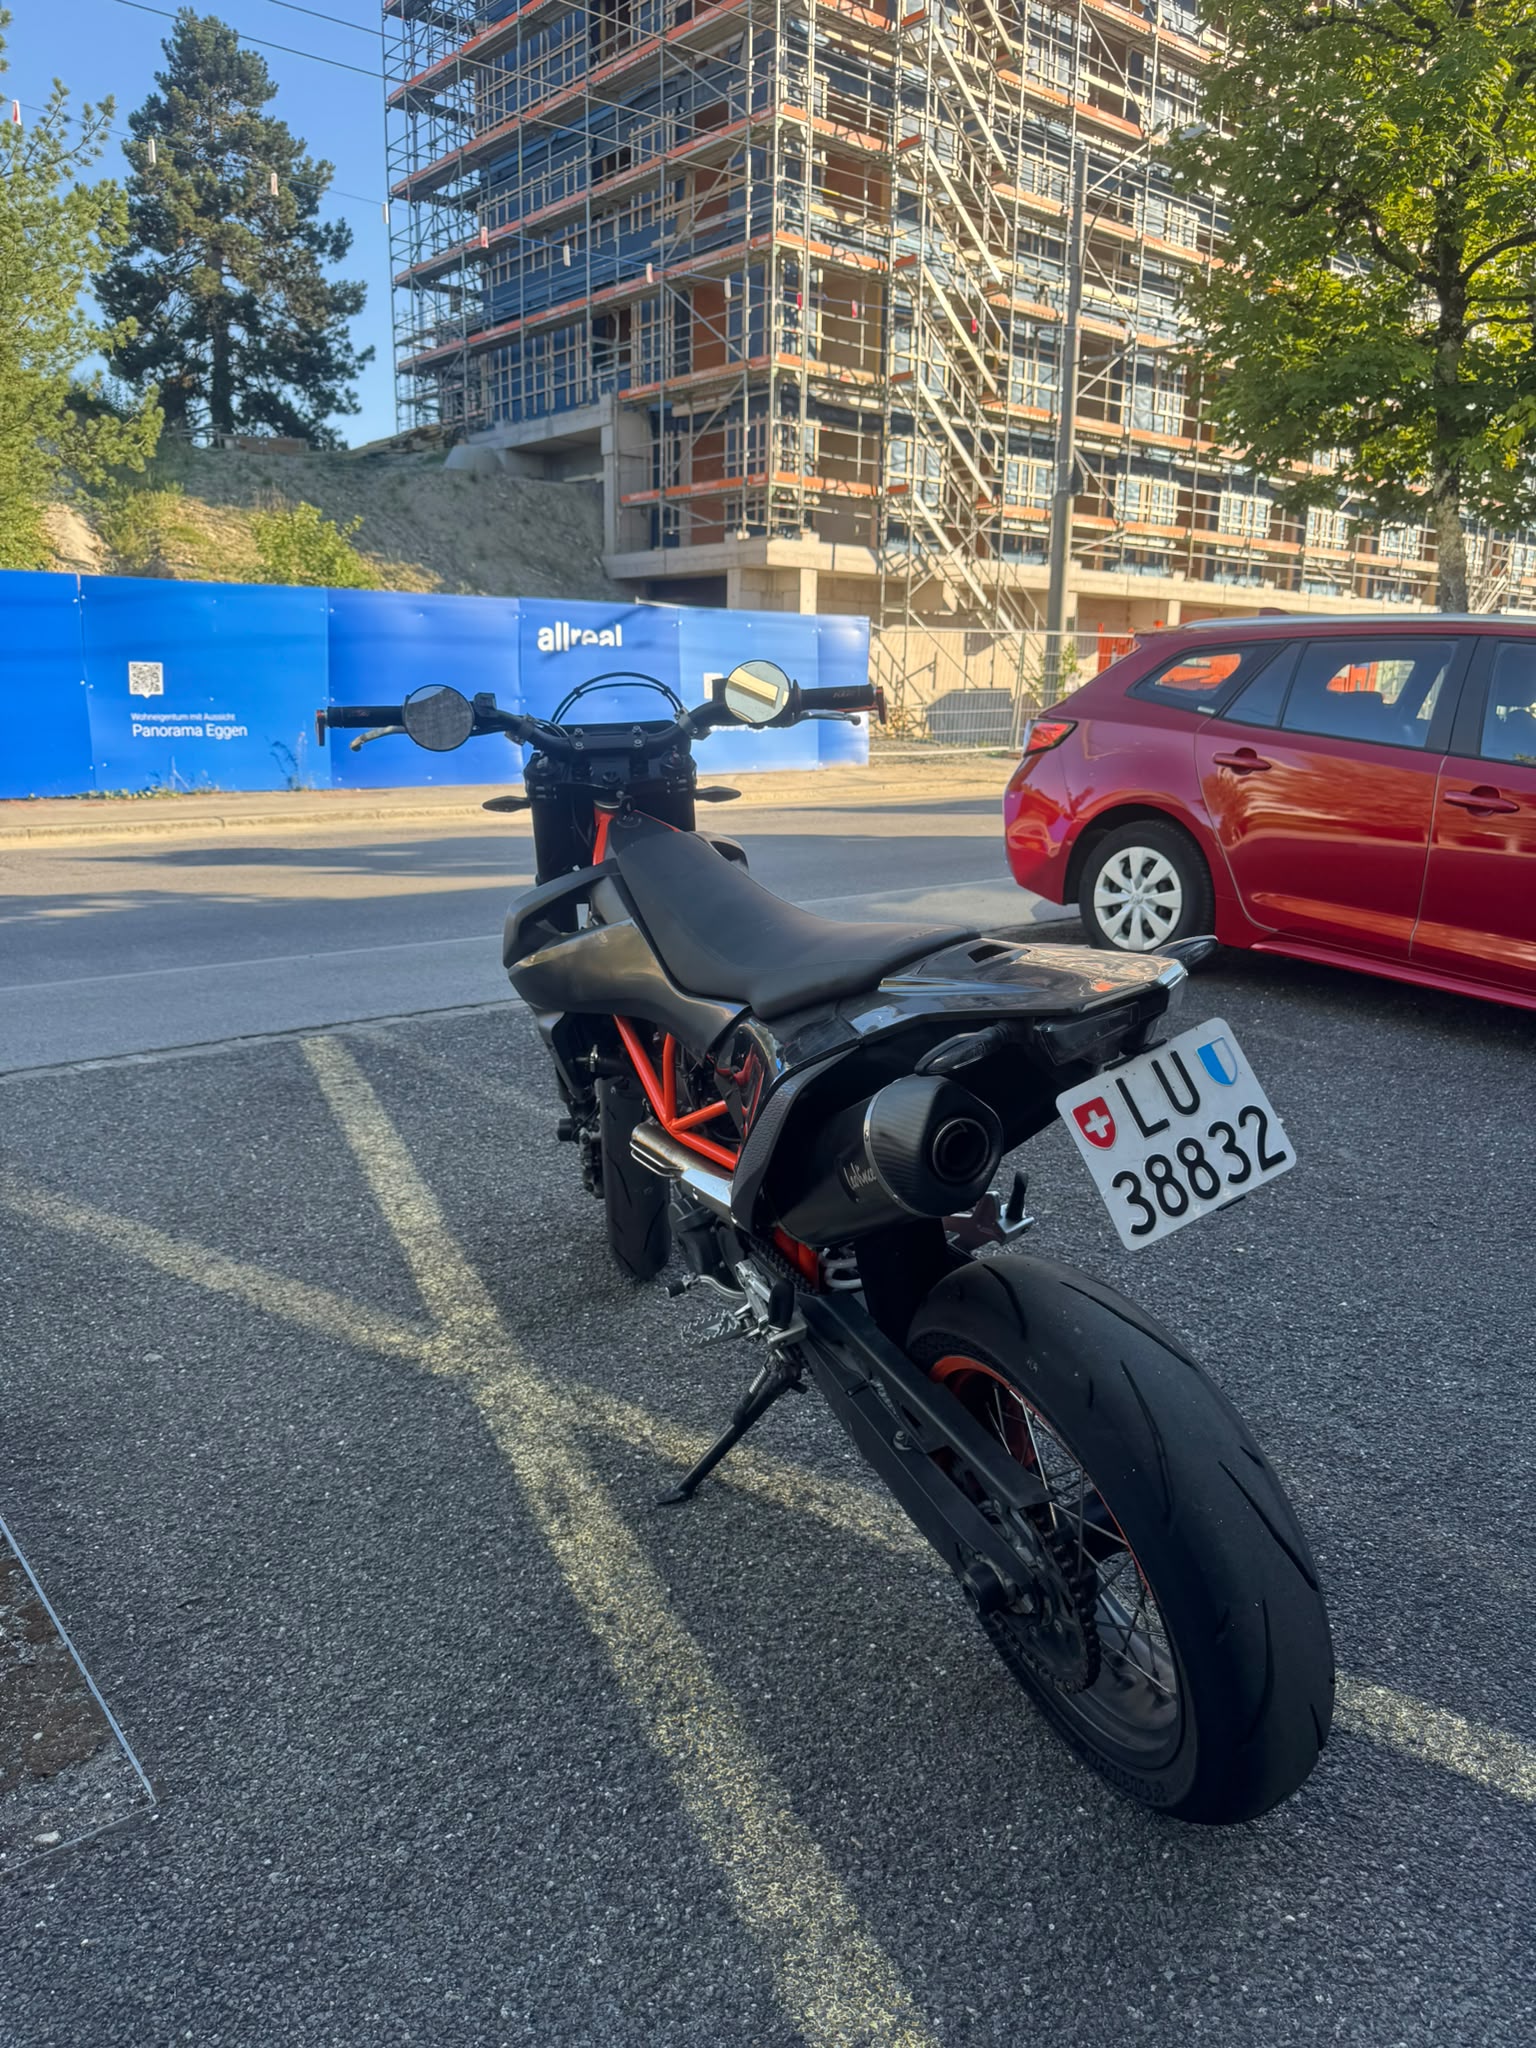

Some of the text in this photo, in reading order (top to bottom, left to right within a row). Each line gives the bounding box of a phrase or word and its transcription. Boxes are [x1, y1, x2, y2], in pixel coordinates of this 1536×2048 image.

[537, 621, 622, 652] allreal
[132, 724, 248, 740] Panorama Eggen
[190, 713, 202, 721] mit
[204, 713, 235, 721] Aussicht
[1115, 1050, 1200, 1138] LU
[1112, 1105, 1287, 1235] 38832
